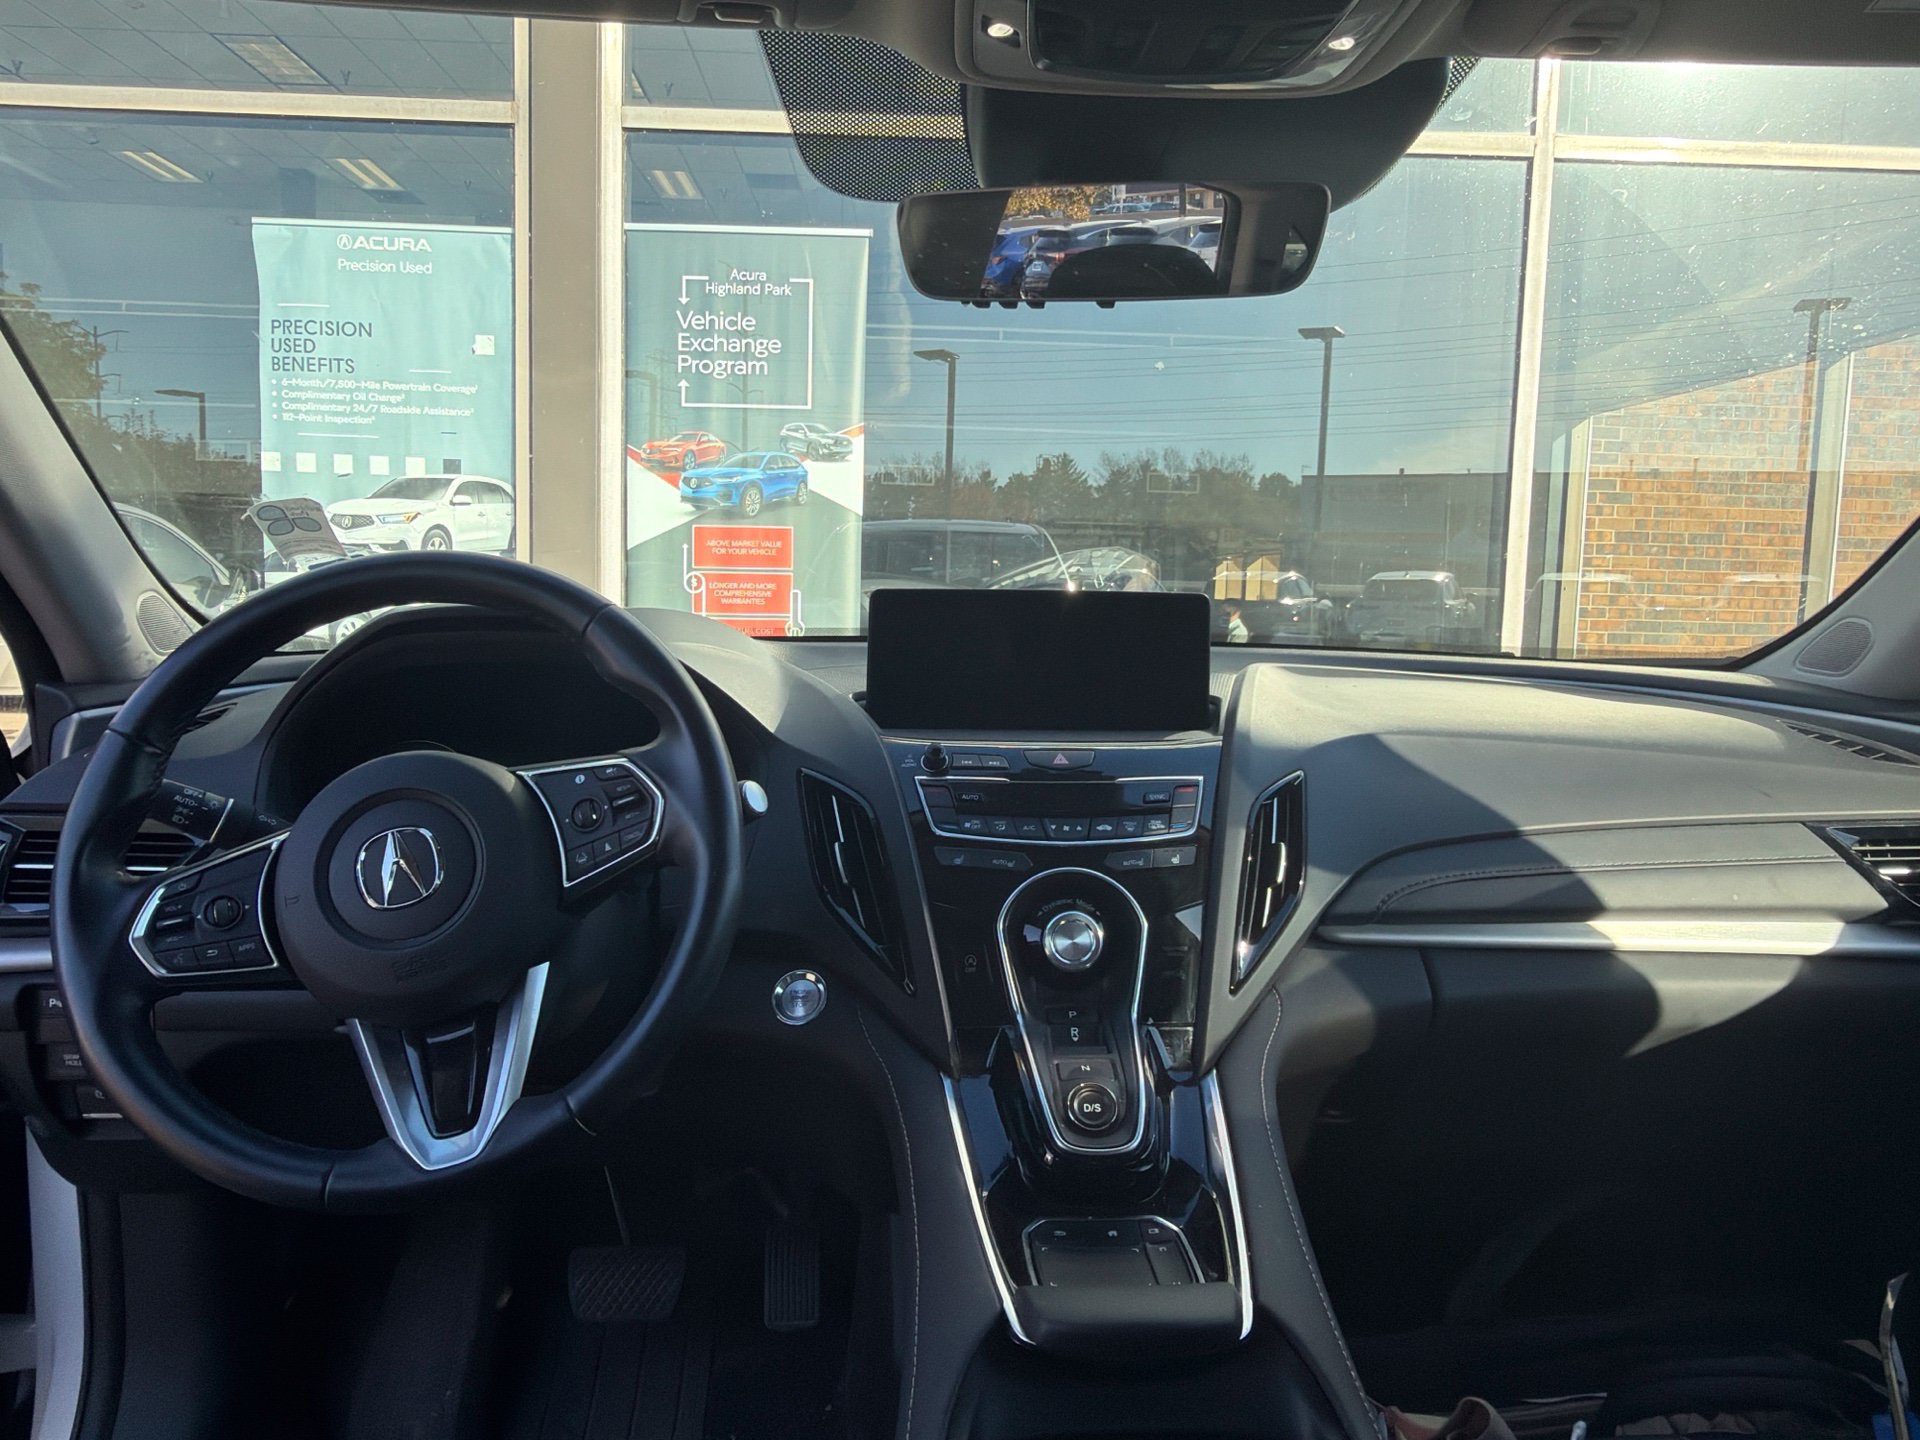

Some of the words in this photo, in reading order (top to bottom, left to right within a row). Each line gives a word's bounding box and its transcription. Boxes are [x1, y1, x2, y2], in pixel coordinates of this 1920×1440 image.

[352, 236, 432, 252] ACURA
[338, 258, 396, 273] Precision
[400, 261, 432, 275] Used
[730, 268, 767, 281] Acura
[705, 282, 761, 297] Highland
[765, 283, 792, 296] Park
[676, 310, 756, 331] Vehicle
[271, 319, 373, 338] PRECISION
[271, 338, 316, 353] USED
[678, 333, 782, 358] Exchange
[271, 356, 355, 374] BENEFITS
[678, 355, 768, 379] Program
[382, 381, 431, 392] Powertrain
[281, 389, 351, 402] Complimentary
[353, 391, 367, 401] Oil
[281, 401, 351, 414] Complimentary
[353, 403, 378, 413] 24/7
[380, 405, 421, 415] Roadside
[182, 788, 198, 798] OFF
[961, 793, 979, 801] AUTO
[174, 794, 195, 806] AUTO
[1068, 1010, 1077, 1019] P
[1070, 1027, 1079, 1038] R
[1081, 1064, 1090, 1072] N
[1083, 1103, 1102, 1113] D/S
